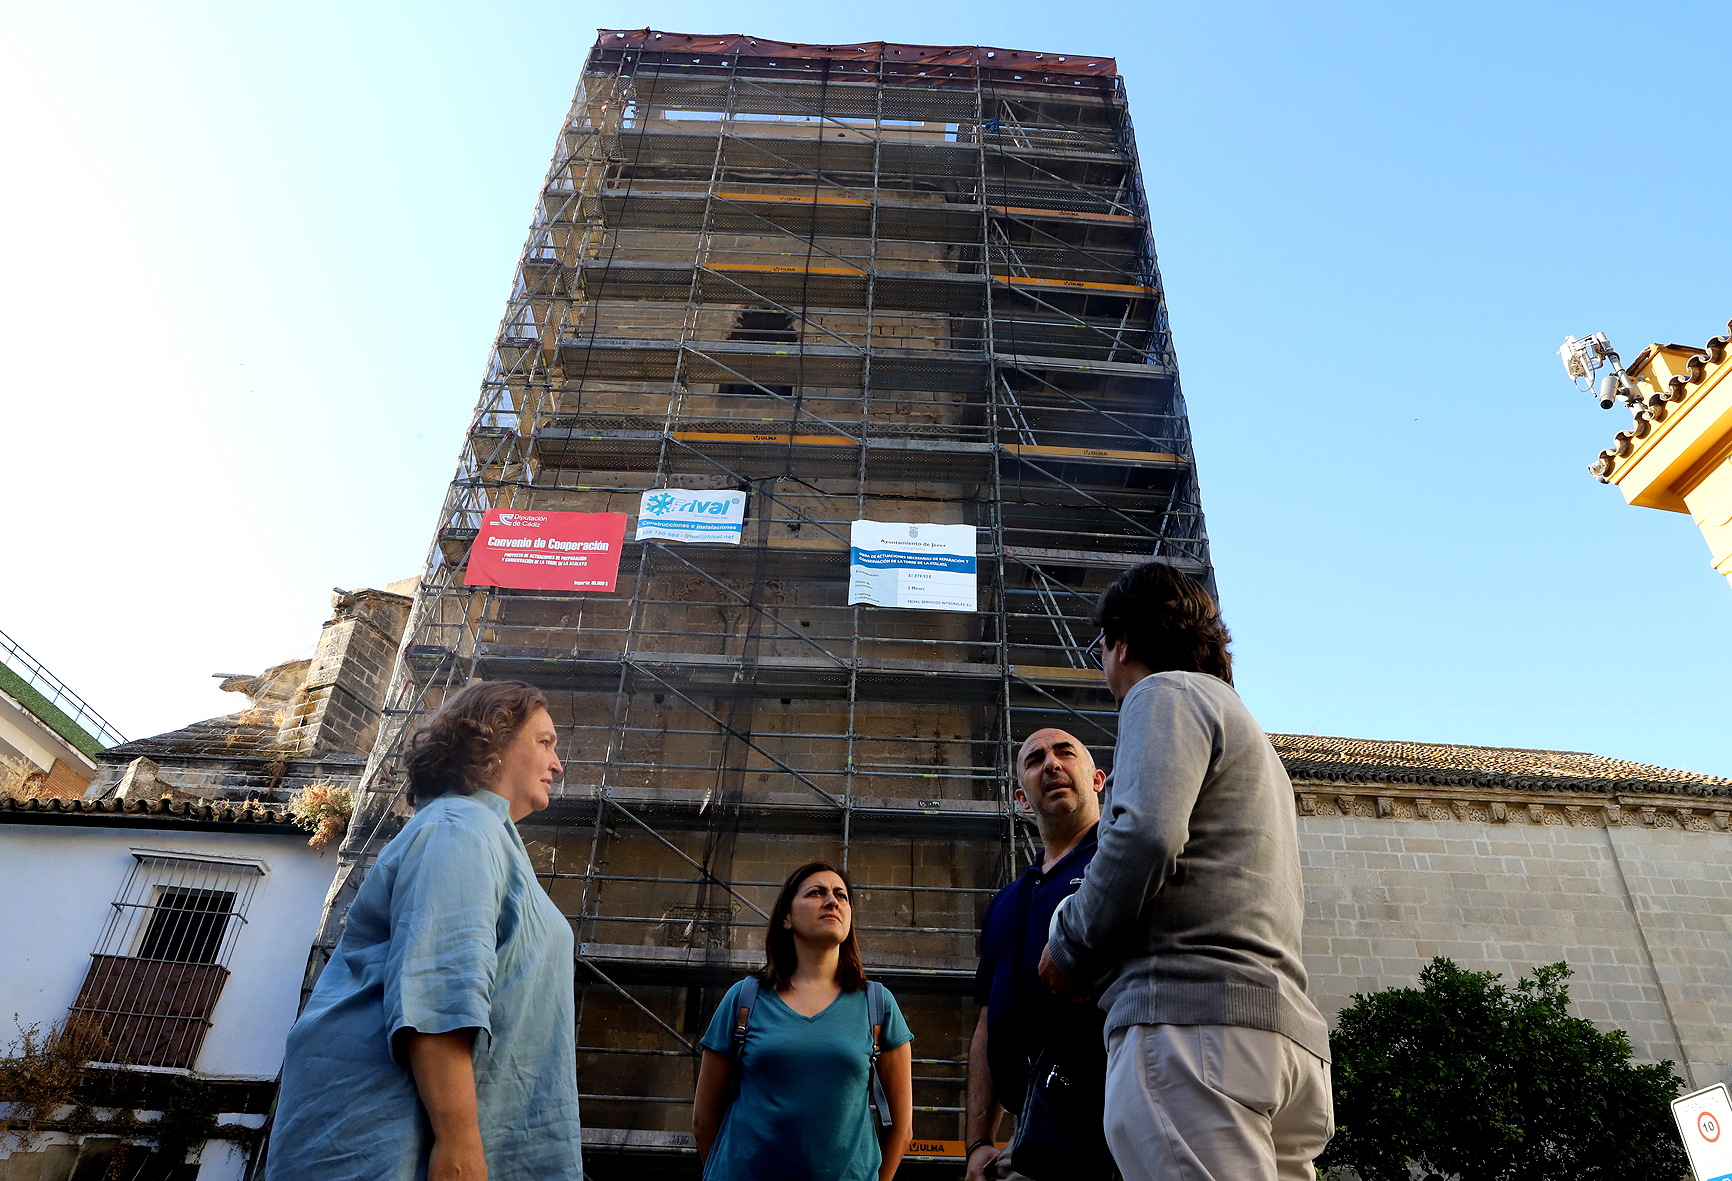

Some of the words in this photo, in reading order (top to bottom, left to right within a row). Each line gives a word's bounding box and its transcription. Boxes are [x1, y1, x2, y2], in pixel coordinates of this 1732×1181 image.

[514, 514, 548, 522] Diputación
[642, 520, 690, 528] Construcciones
[487, 536, 532, 548] Convenio
[534, 538, 545, 548] de
[548, 538, 609, 551] Cooperación
[1703, 1121, 1715, 1132] 10
[920, 1144, 945, 1152] ULMA
